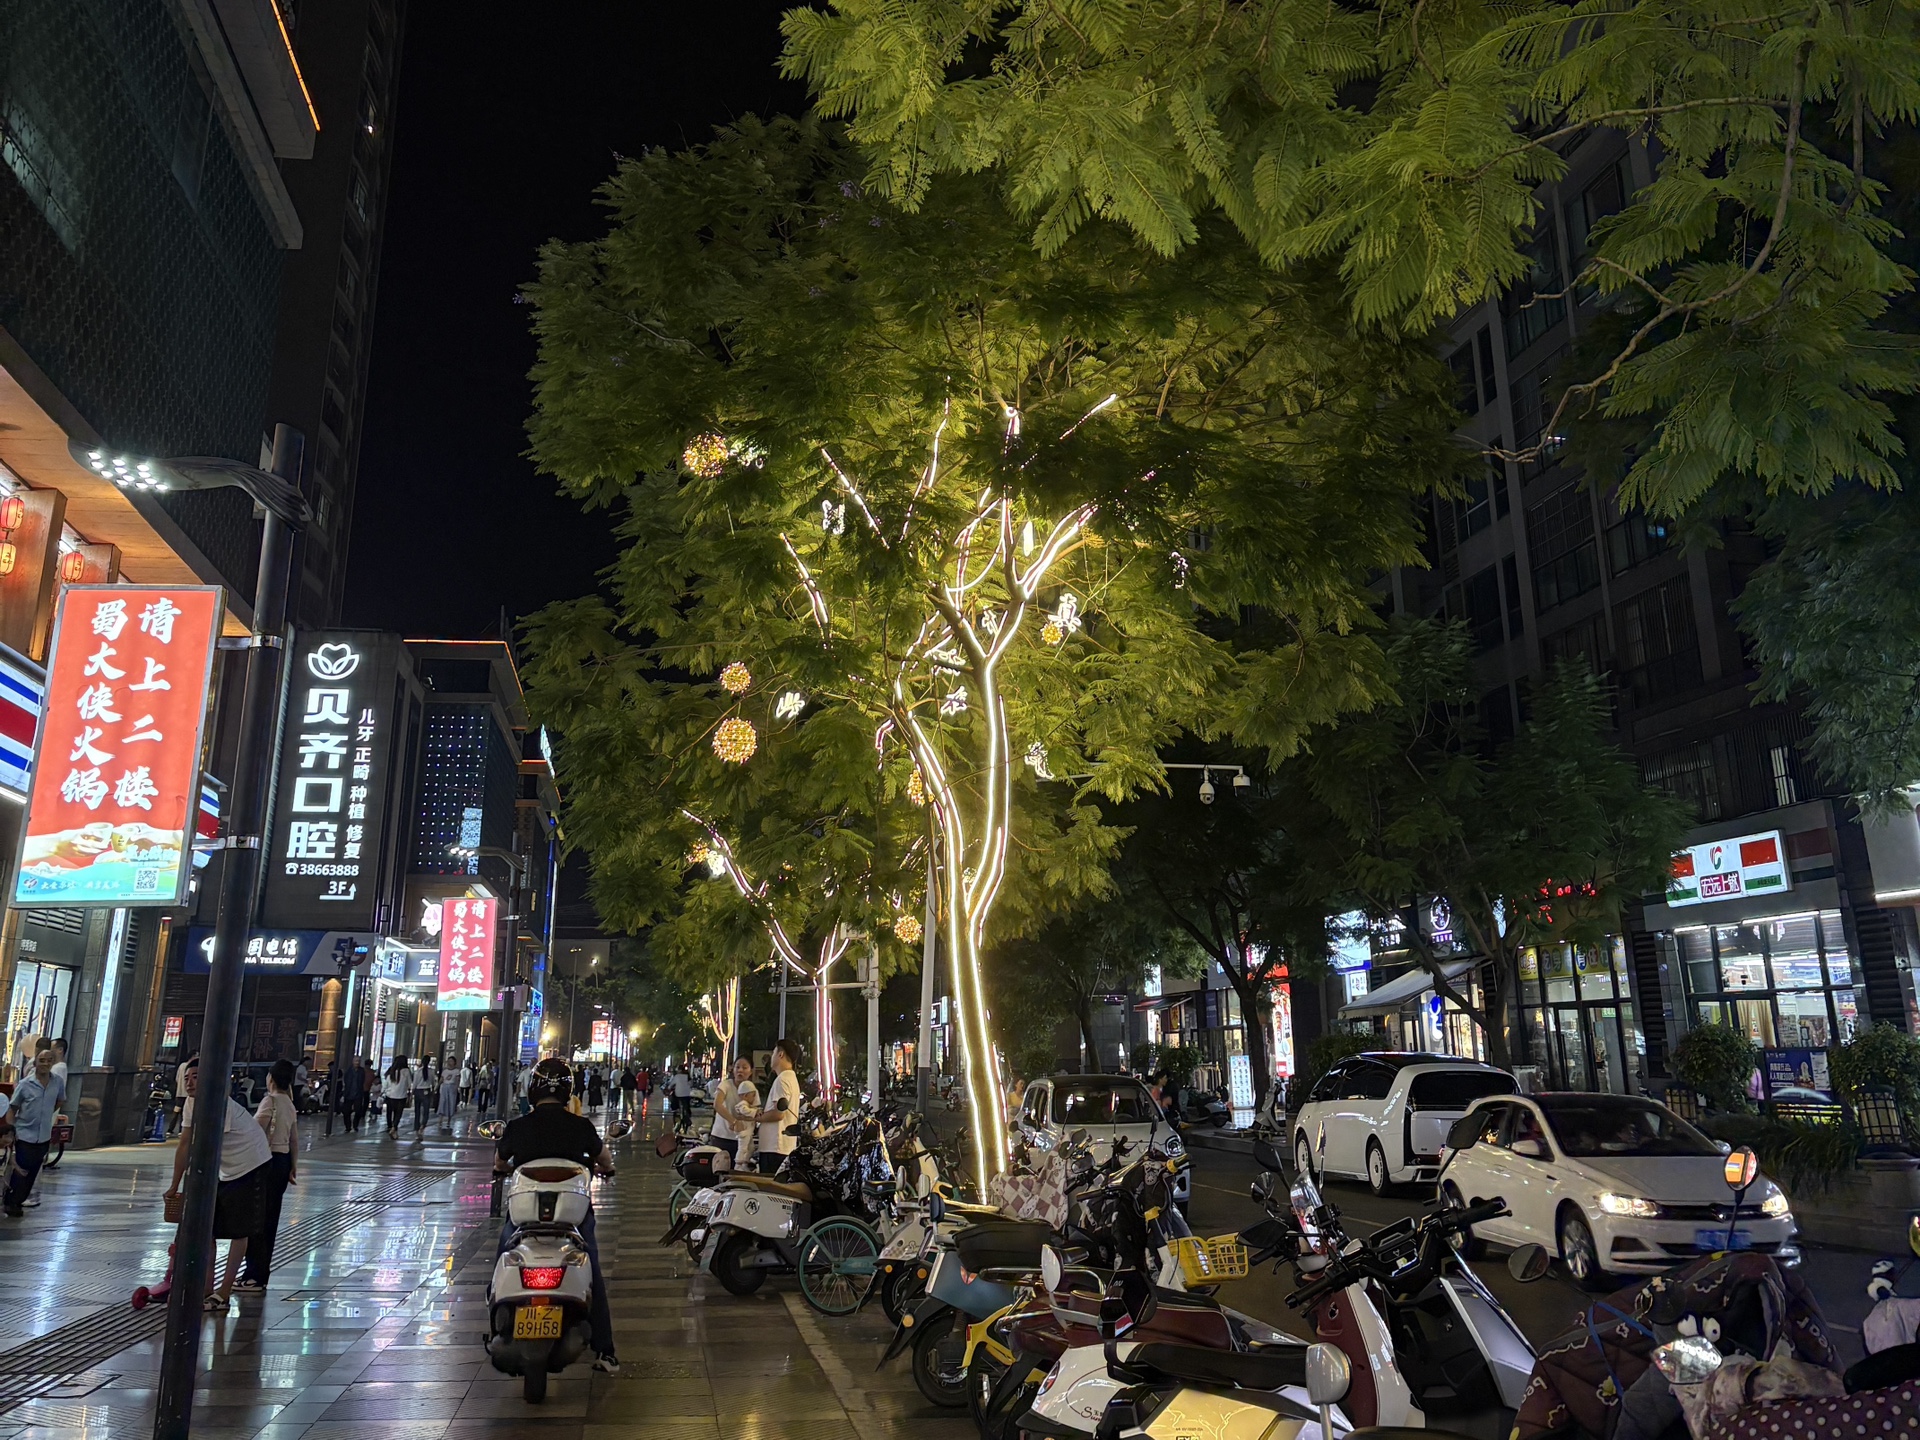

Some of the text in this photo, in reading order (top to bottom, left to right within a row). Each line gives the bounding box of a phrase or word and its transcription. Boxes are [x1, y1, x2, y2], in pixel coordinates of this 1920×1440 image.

[61, 599, 128, 810] 蜀大侠火锅
[114, 597, 182, 810] 请上二楼
[286, 688, 350, 859] 贝齐口腔
[343, 708, 375, 859] 儿牙 正畸 种植 修复
[299, 863, 359, 877] 38663888
[328, 881, 347, 894] 3F
[260, 957, 295, 965] TELECOM
[467, 900, 488, 984] 请上二楼
[517, 1321, 559, 1336] 89H58
